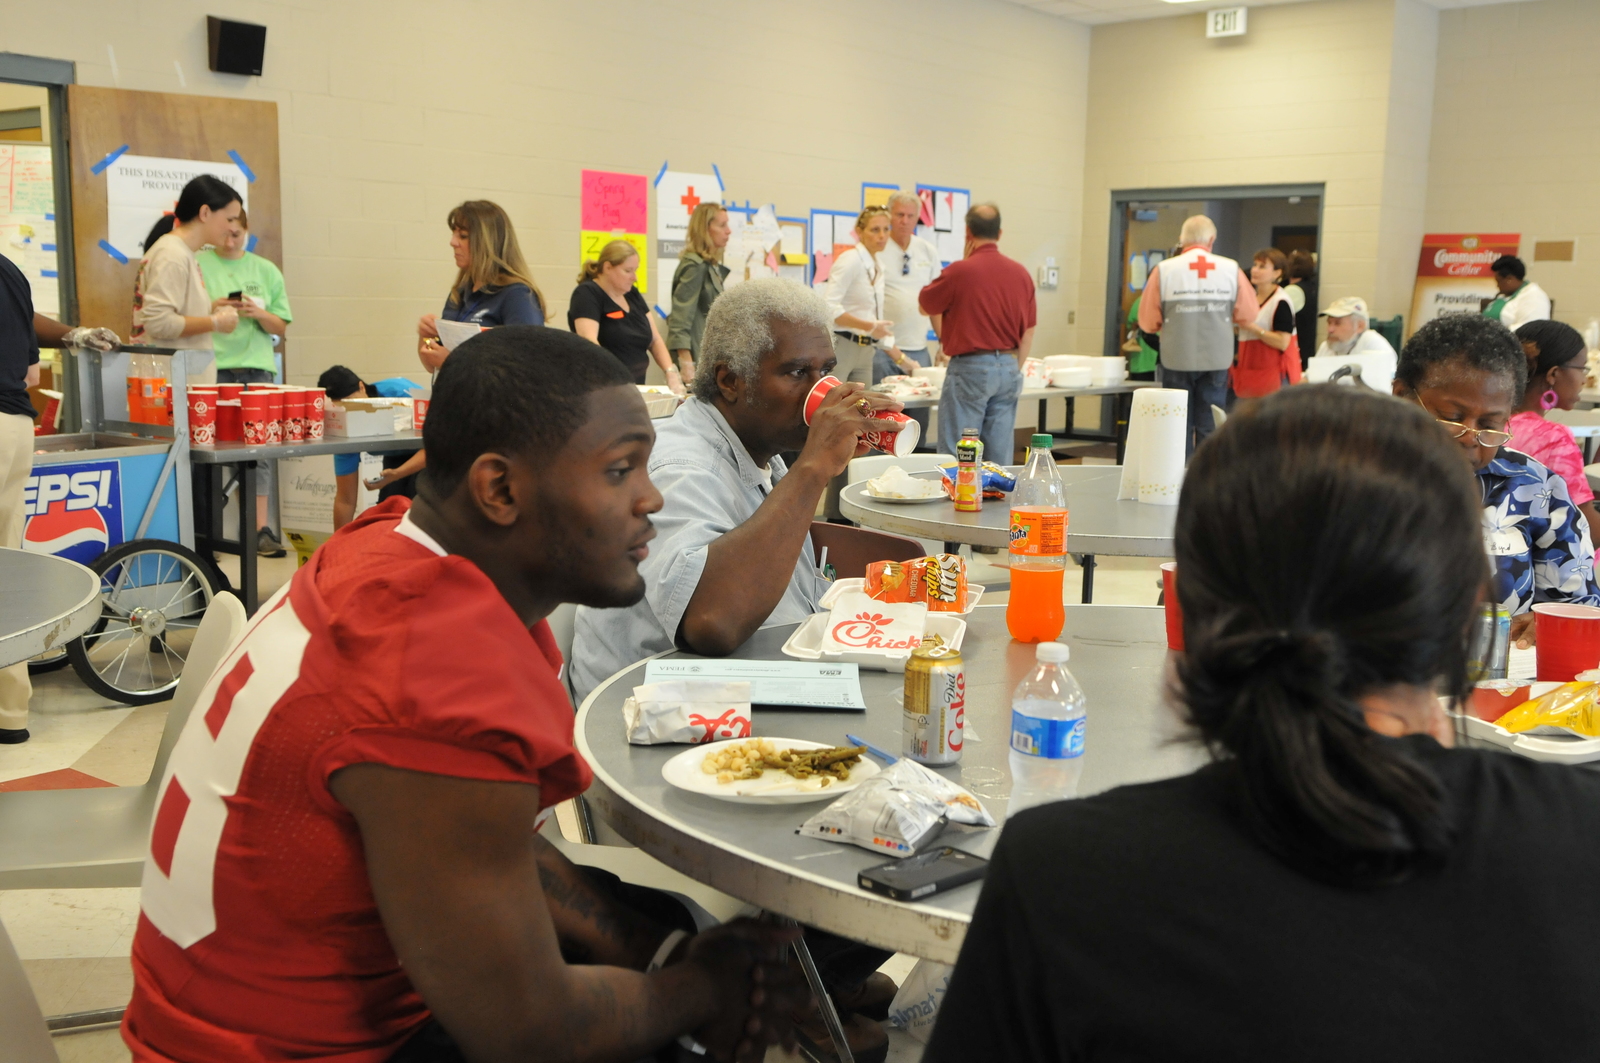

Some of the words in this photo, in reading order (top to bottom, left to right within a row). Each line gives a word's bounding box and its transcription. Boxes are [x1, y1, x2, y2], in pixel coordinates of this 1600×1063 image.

[1215, 11, 1238, 32] EXIT
[118, 167, 143, 176] THIS
[1434, 249, 1502, 268] Community
[1448, 263, 1482, 276] Coffee
[1175, 303, 1206, 313] Disaster
[1010, 529, 1027, 541] anta
[909, 569, 919, 598] CHEDDAR
[923, 557, 942, 599] Chips
[940, 556, 961, 603] Sun
[943, 673, 956, 704] Diet
[947, 672, 966, 752] Coke
